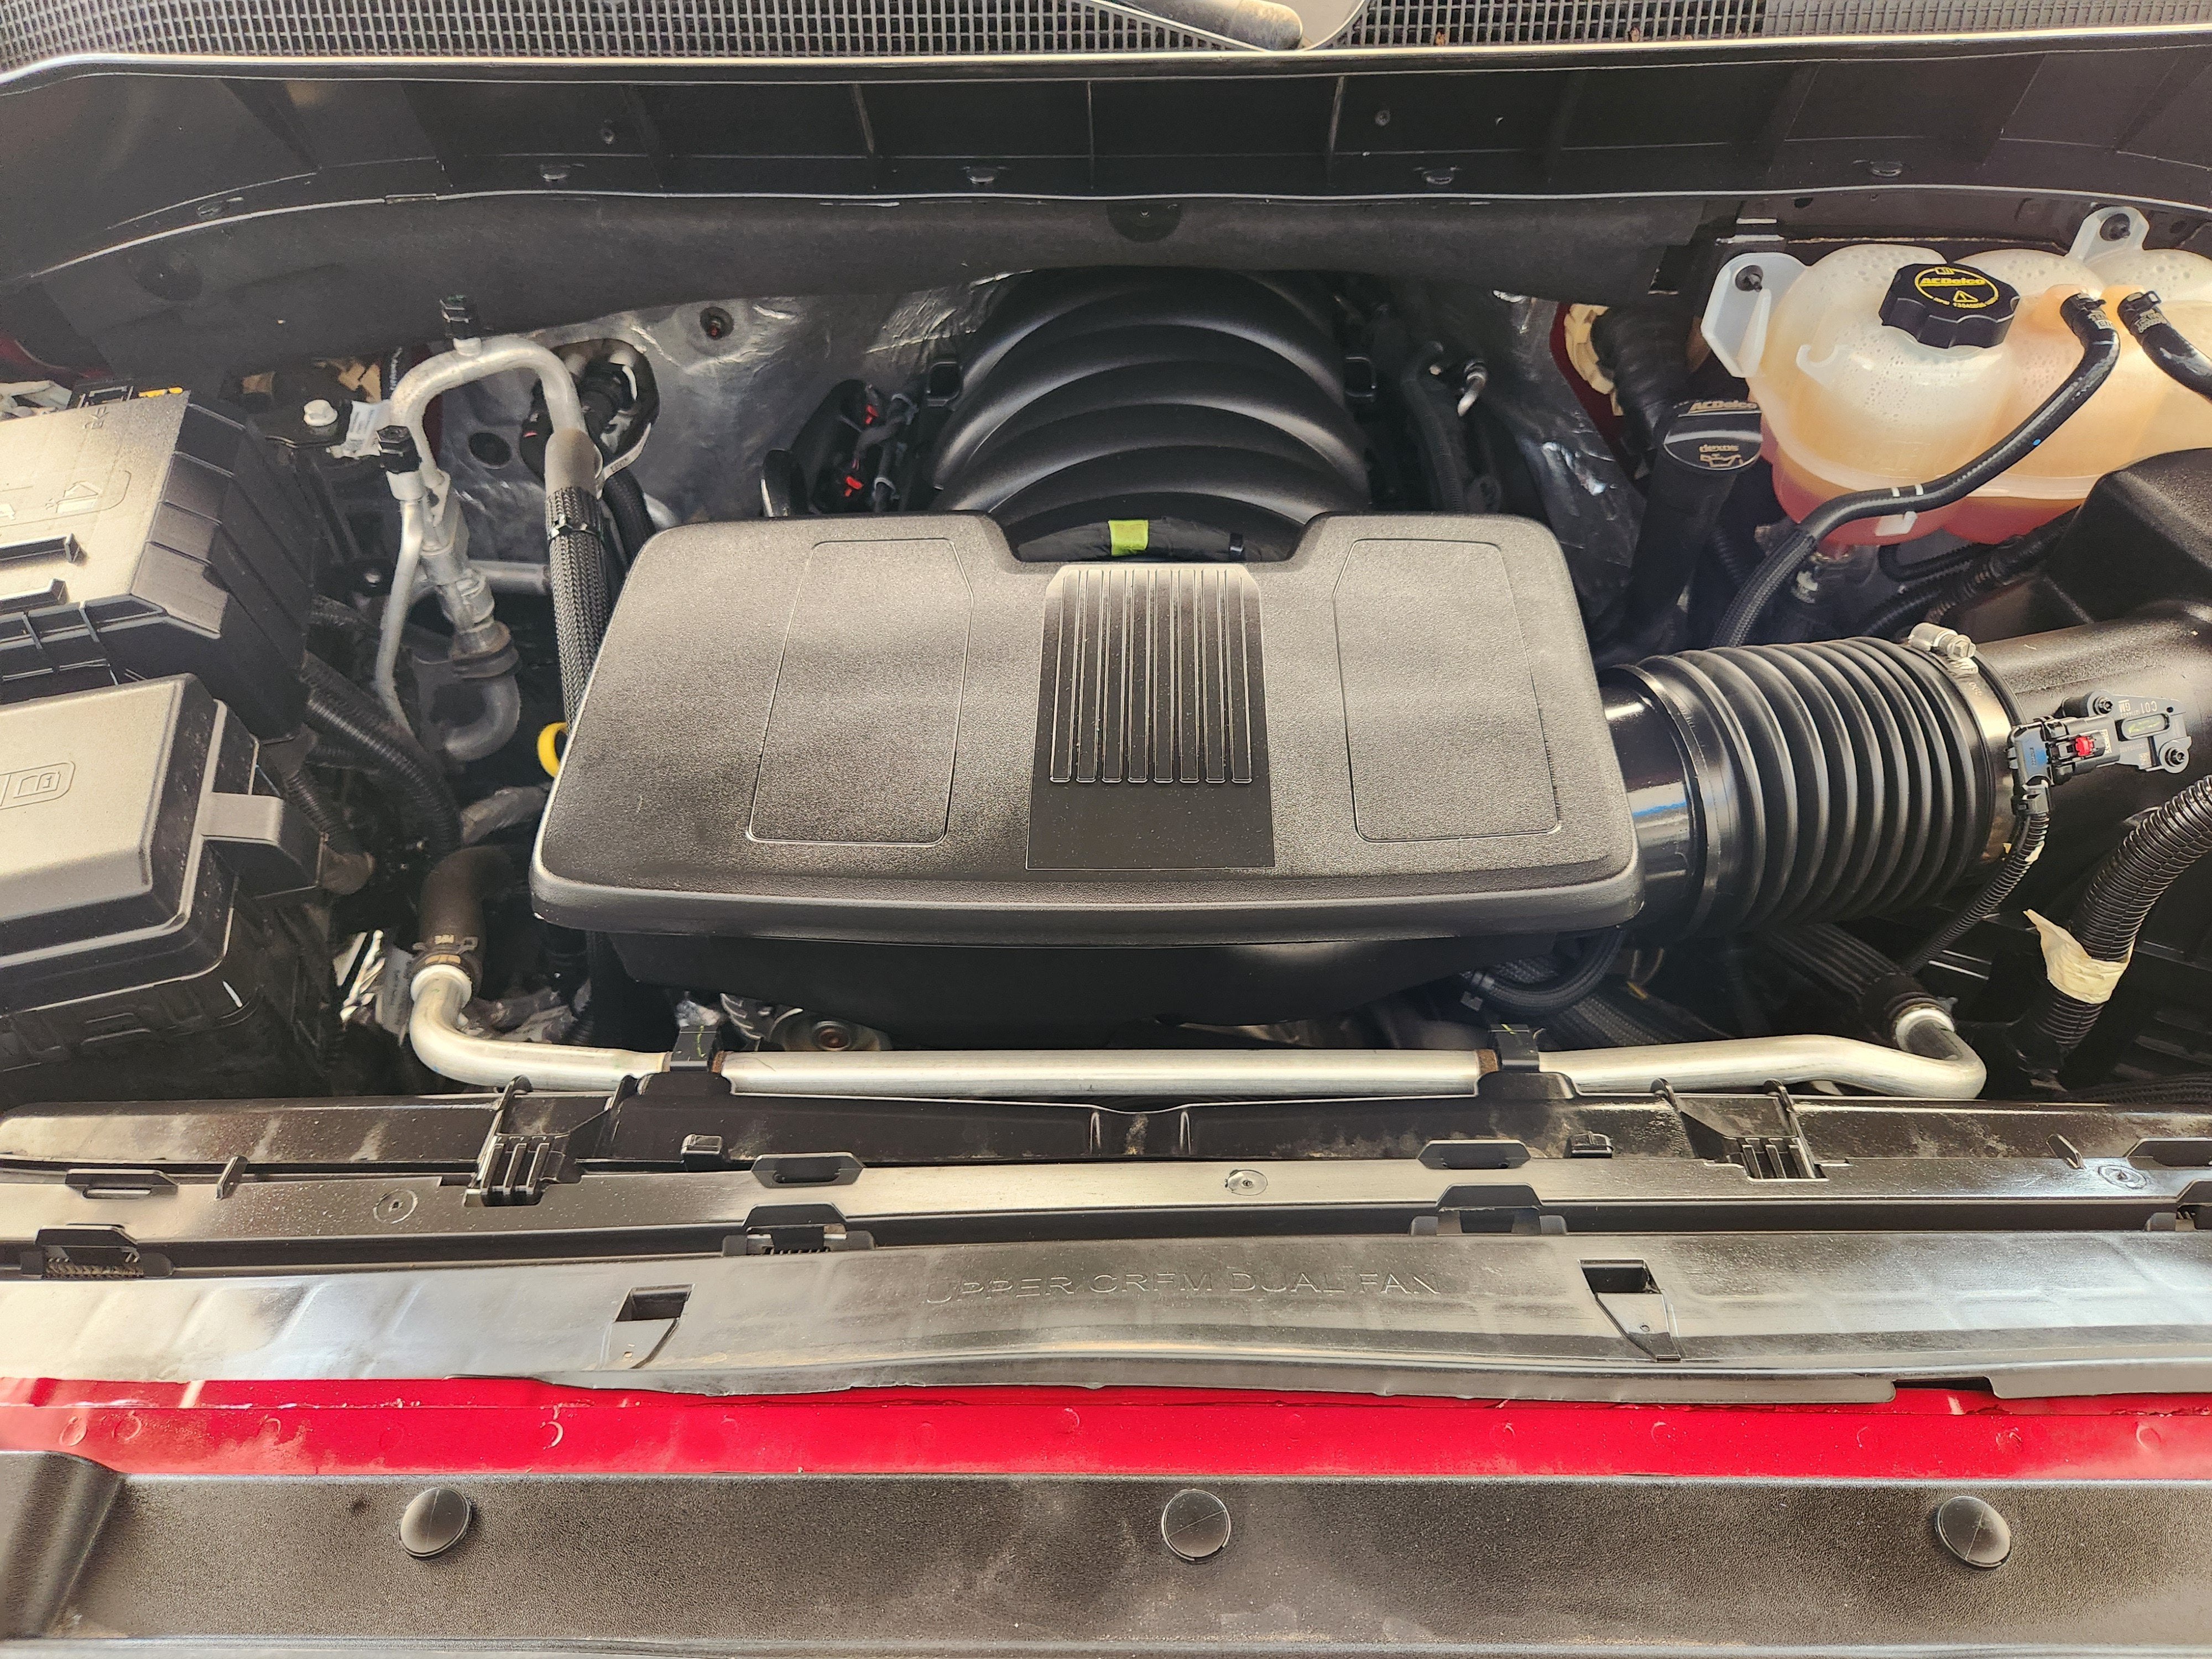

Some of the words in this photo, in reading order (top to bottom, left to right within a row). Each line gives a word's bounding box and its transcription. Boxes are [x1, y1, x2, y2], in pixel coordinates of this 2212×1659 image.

[1919, 276, 1986, 287] ACDelco
[1688, 400, 1758, 413] ACDelco
[1699, 445, 1739, 453] dexos
[2118, 700, 2131, 713] GM
[926, 1276, 1074, 1303] UPPER
[1229, 1272, 1345, 1293] DUAL
[1354, 1272, 1441, 1294] FAN
